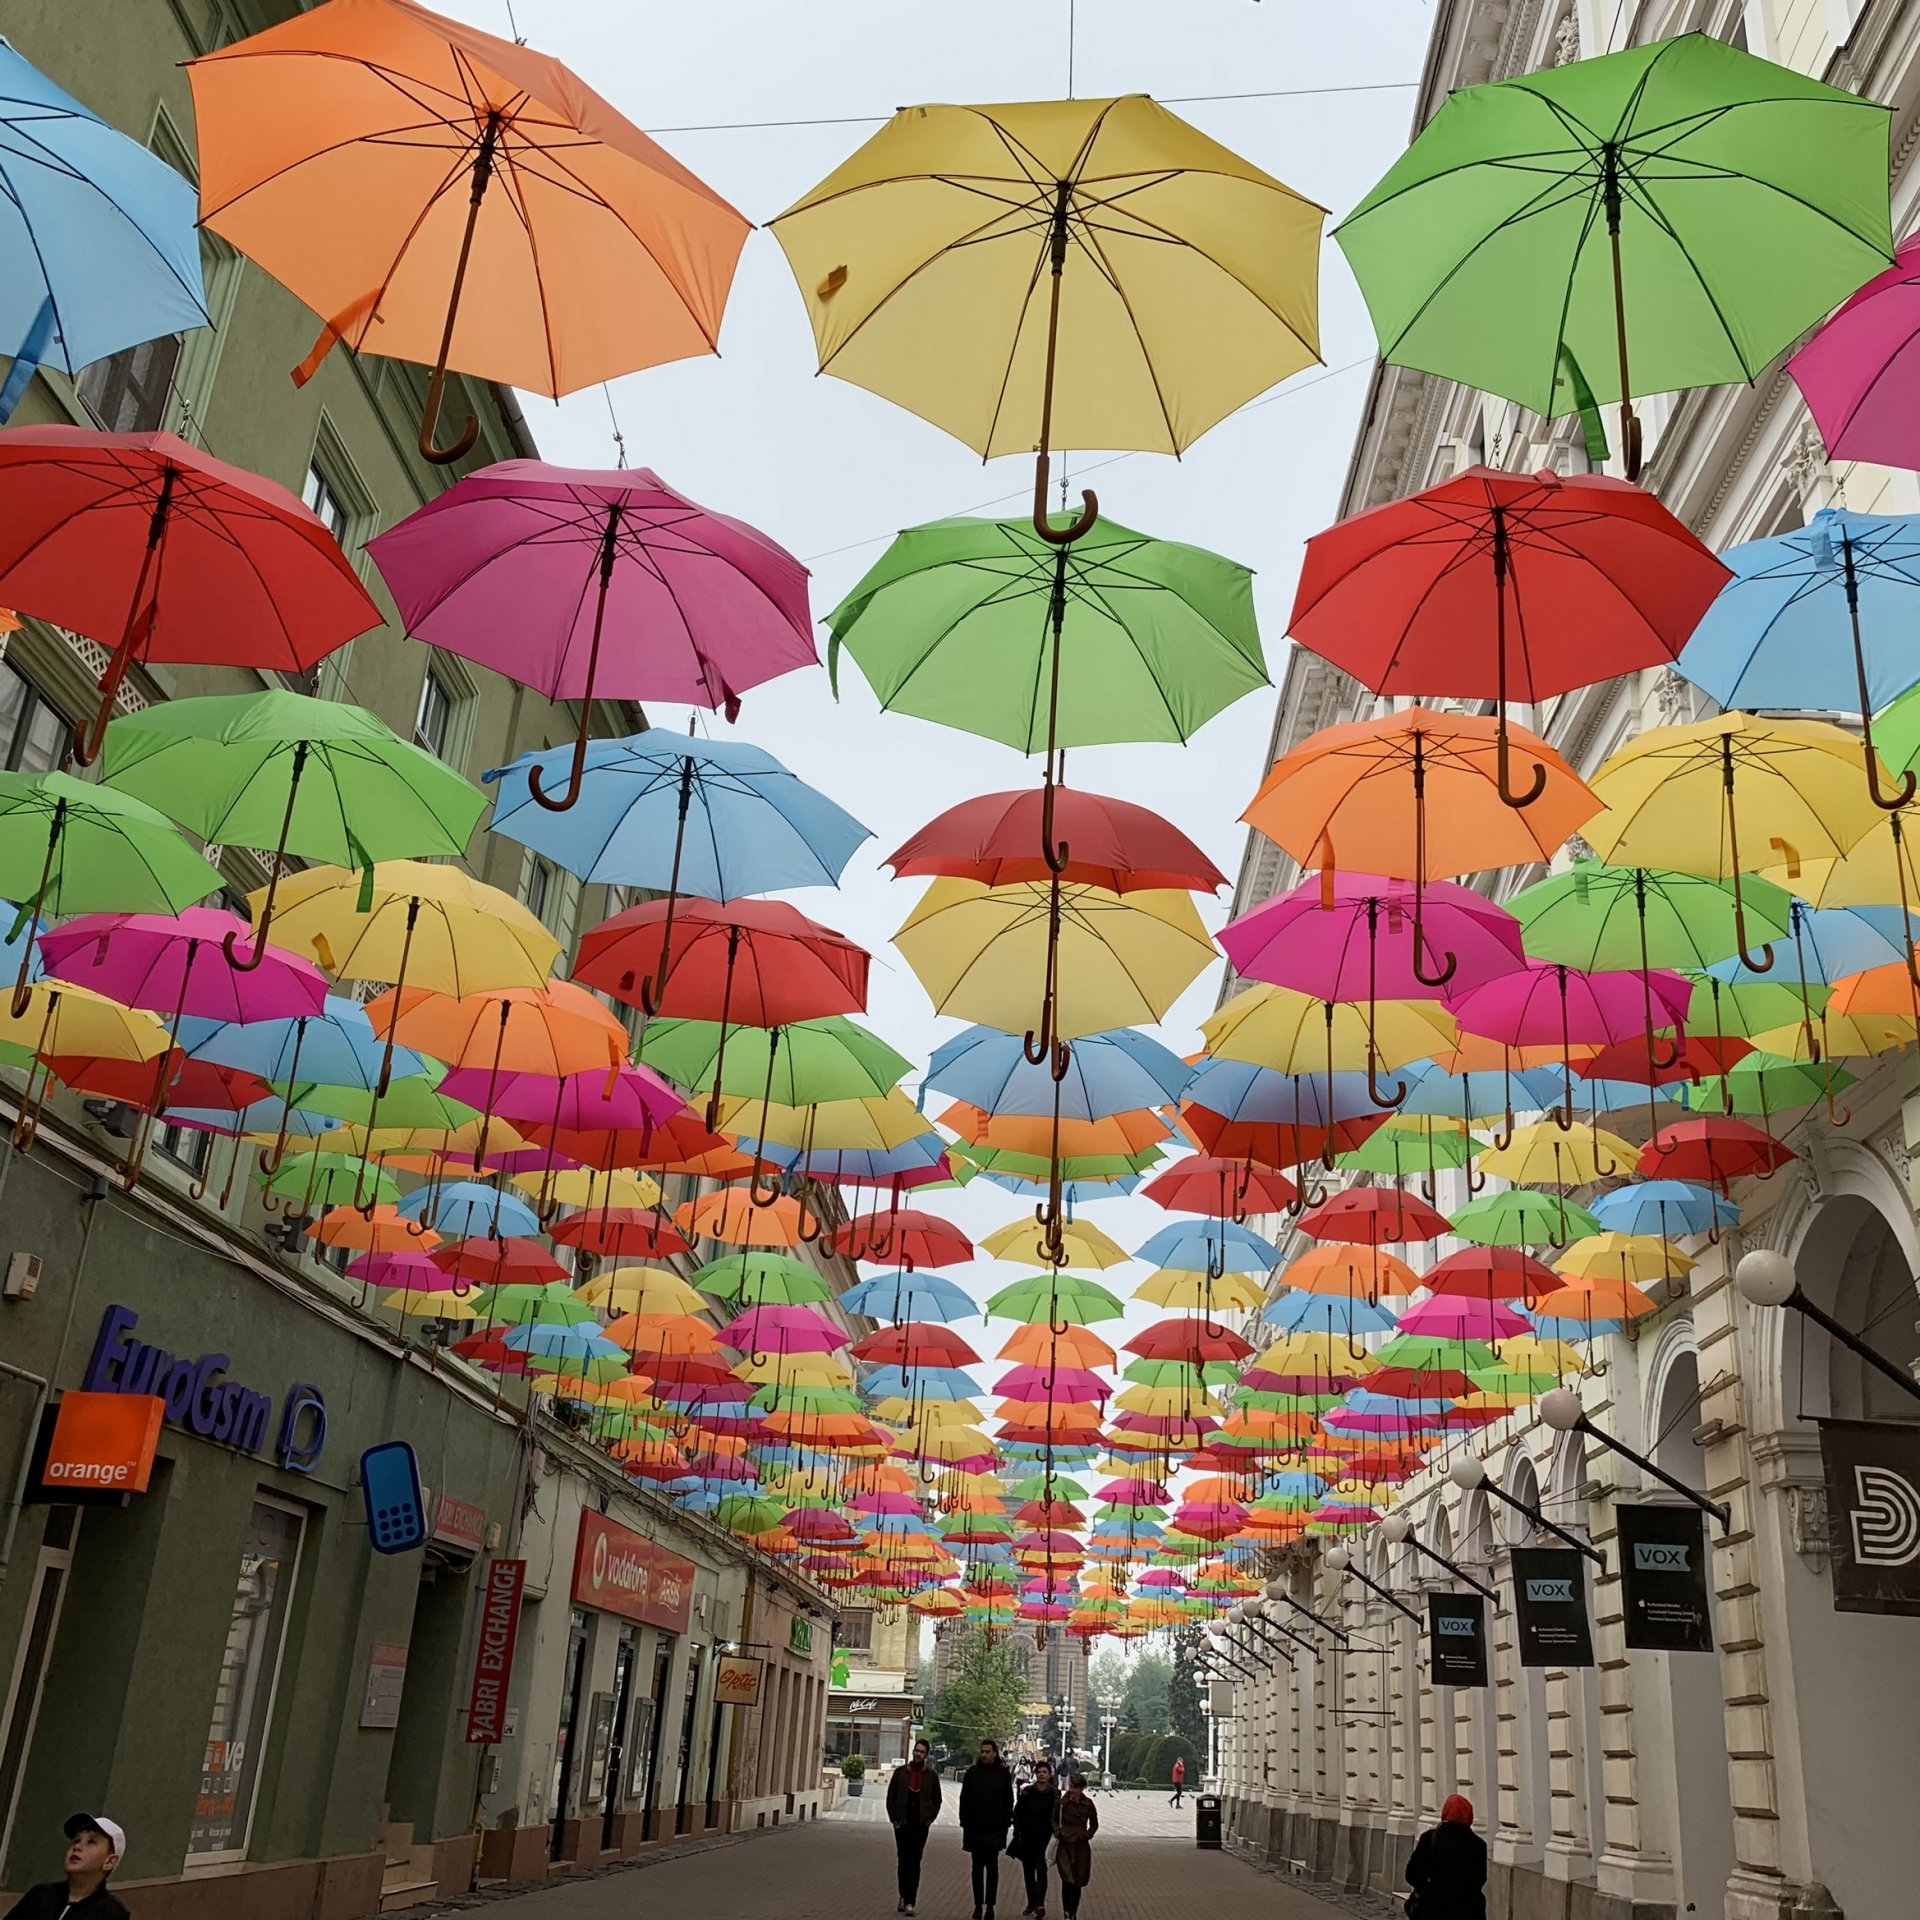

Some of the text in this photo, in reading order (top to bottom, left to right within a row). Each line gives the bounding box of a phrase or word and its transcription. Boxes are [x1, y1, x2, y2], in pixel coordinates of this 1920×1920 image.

[84, 1304, 271, 1453] EuroGsm
[49, 1461, 128, 1484] orange
[1639, 1548, 1681, 1565] VOX
[608, 1550, 648, 1595] vodafone
[1530, 1584, 1566, 1596] VOX
[481, 1563, 517, 1671] EXCHANGE
[1441, 1620, 1469, 1632] VOX
